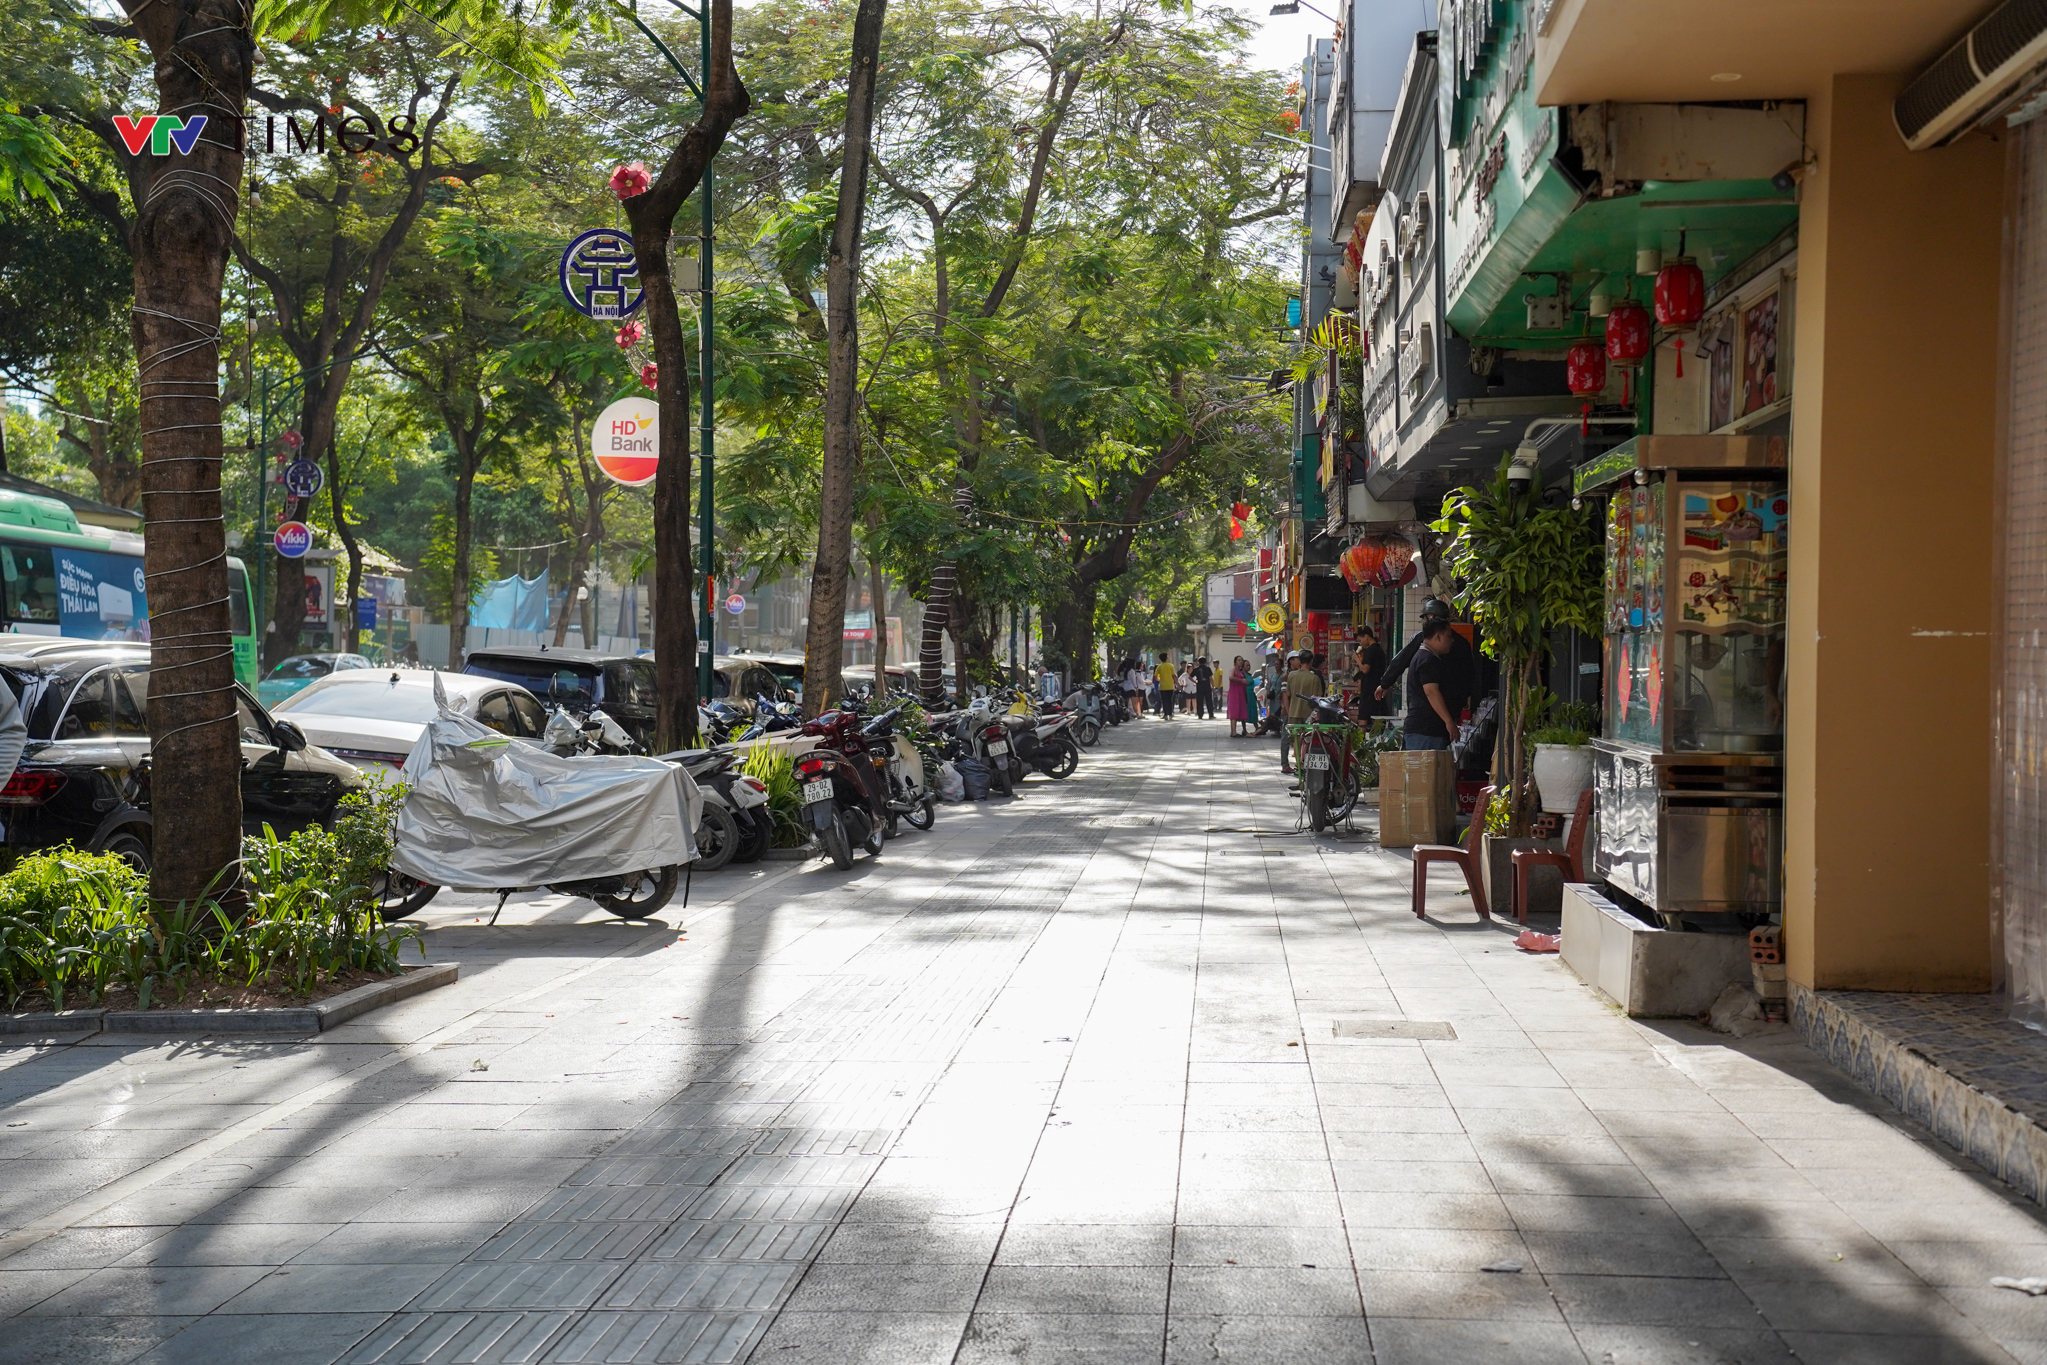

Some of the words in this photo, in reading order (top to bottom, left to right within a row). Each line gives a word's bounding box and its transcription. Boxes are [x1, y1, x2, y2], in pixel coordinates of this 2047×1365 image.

[612, 420, 636, 436] HD
[611, 436, 653, 452] Bank
[278, 528, 306, 544] Vikki
[81, 581, 97, 597] HÒA
[61, 592, 83, 613] THÁI
[84, 599, 98, 612] LAN
[806, 788, 831, 803] 280.22
